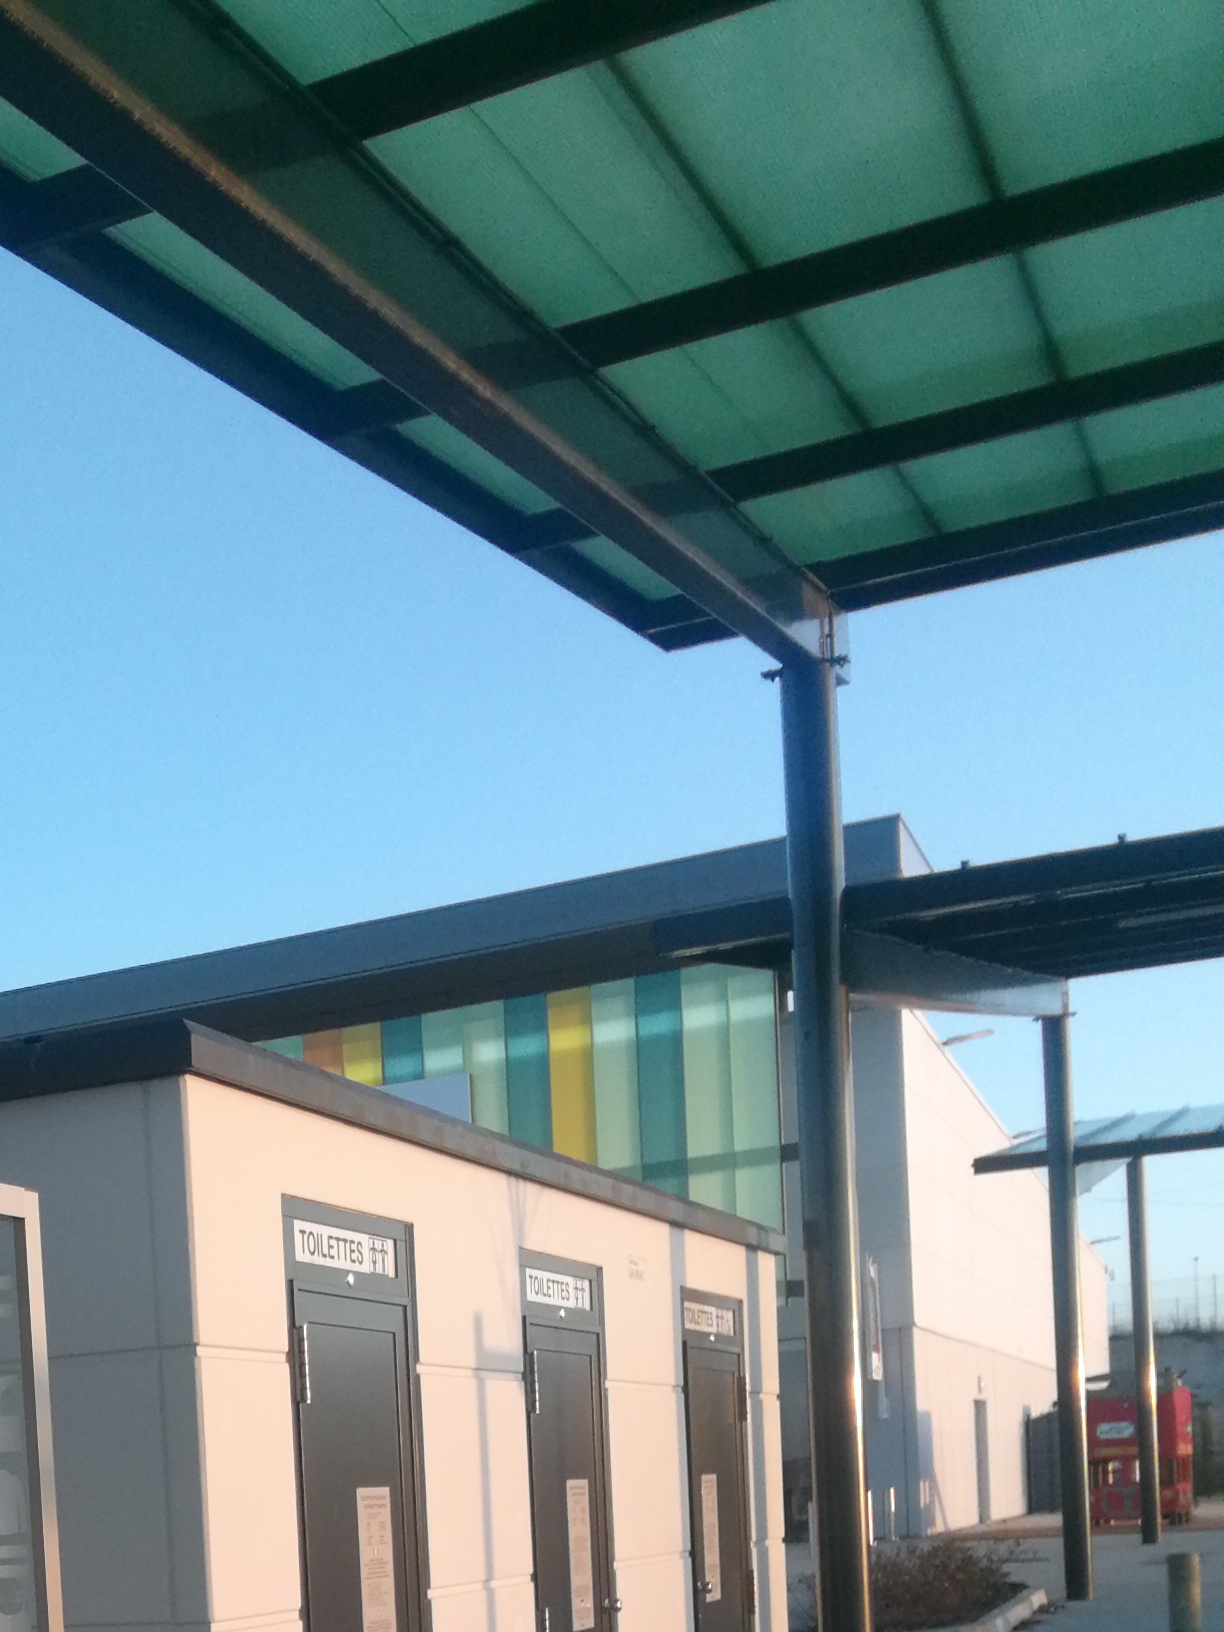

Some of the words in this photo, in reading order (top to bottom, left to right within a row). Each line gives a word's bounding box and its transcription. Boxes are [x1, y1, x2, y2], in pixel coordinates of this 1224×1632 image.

[299, 1229, 364, 1265] TOILETTES
[529, 1274, 571, 1301] TOILETTES
[685, 1307, 714, 1328] TOILETTES
